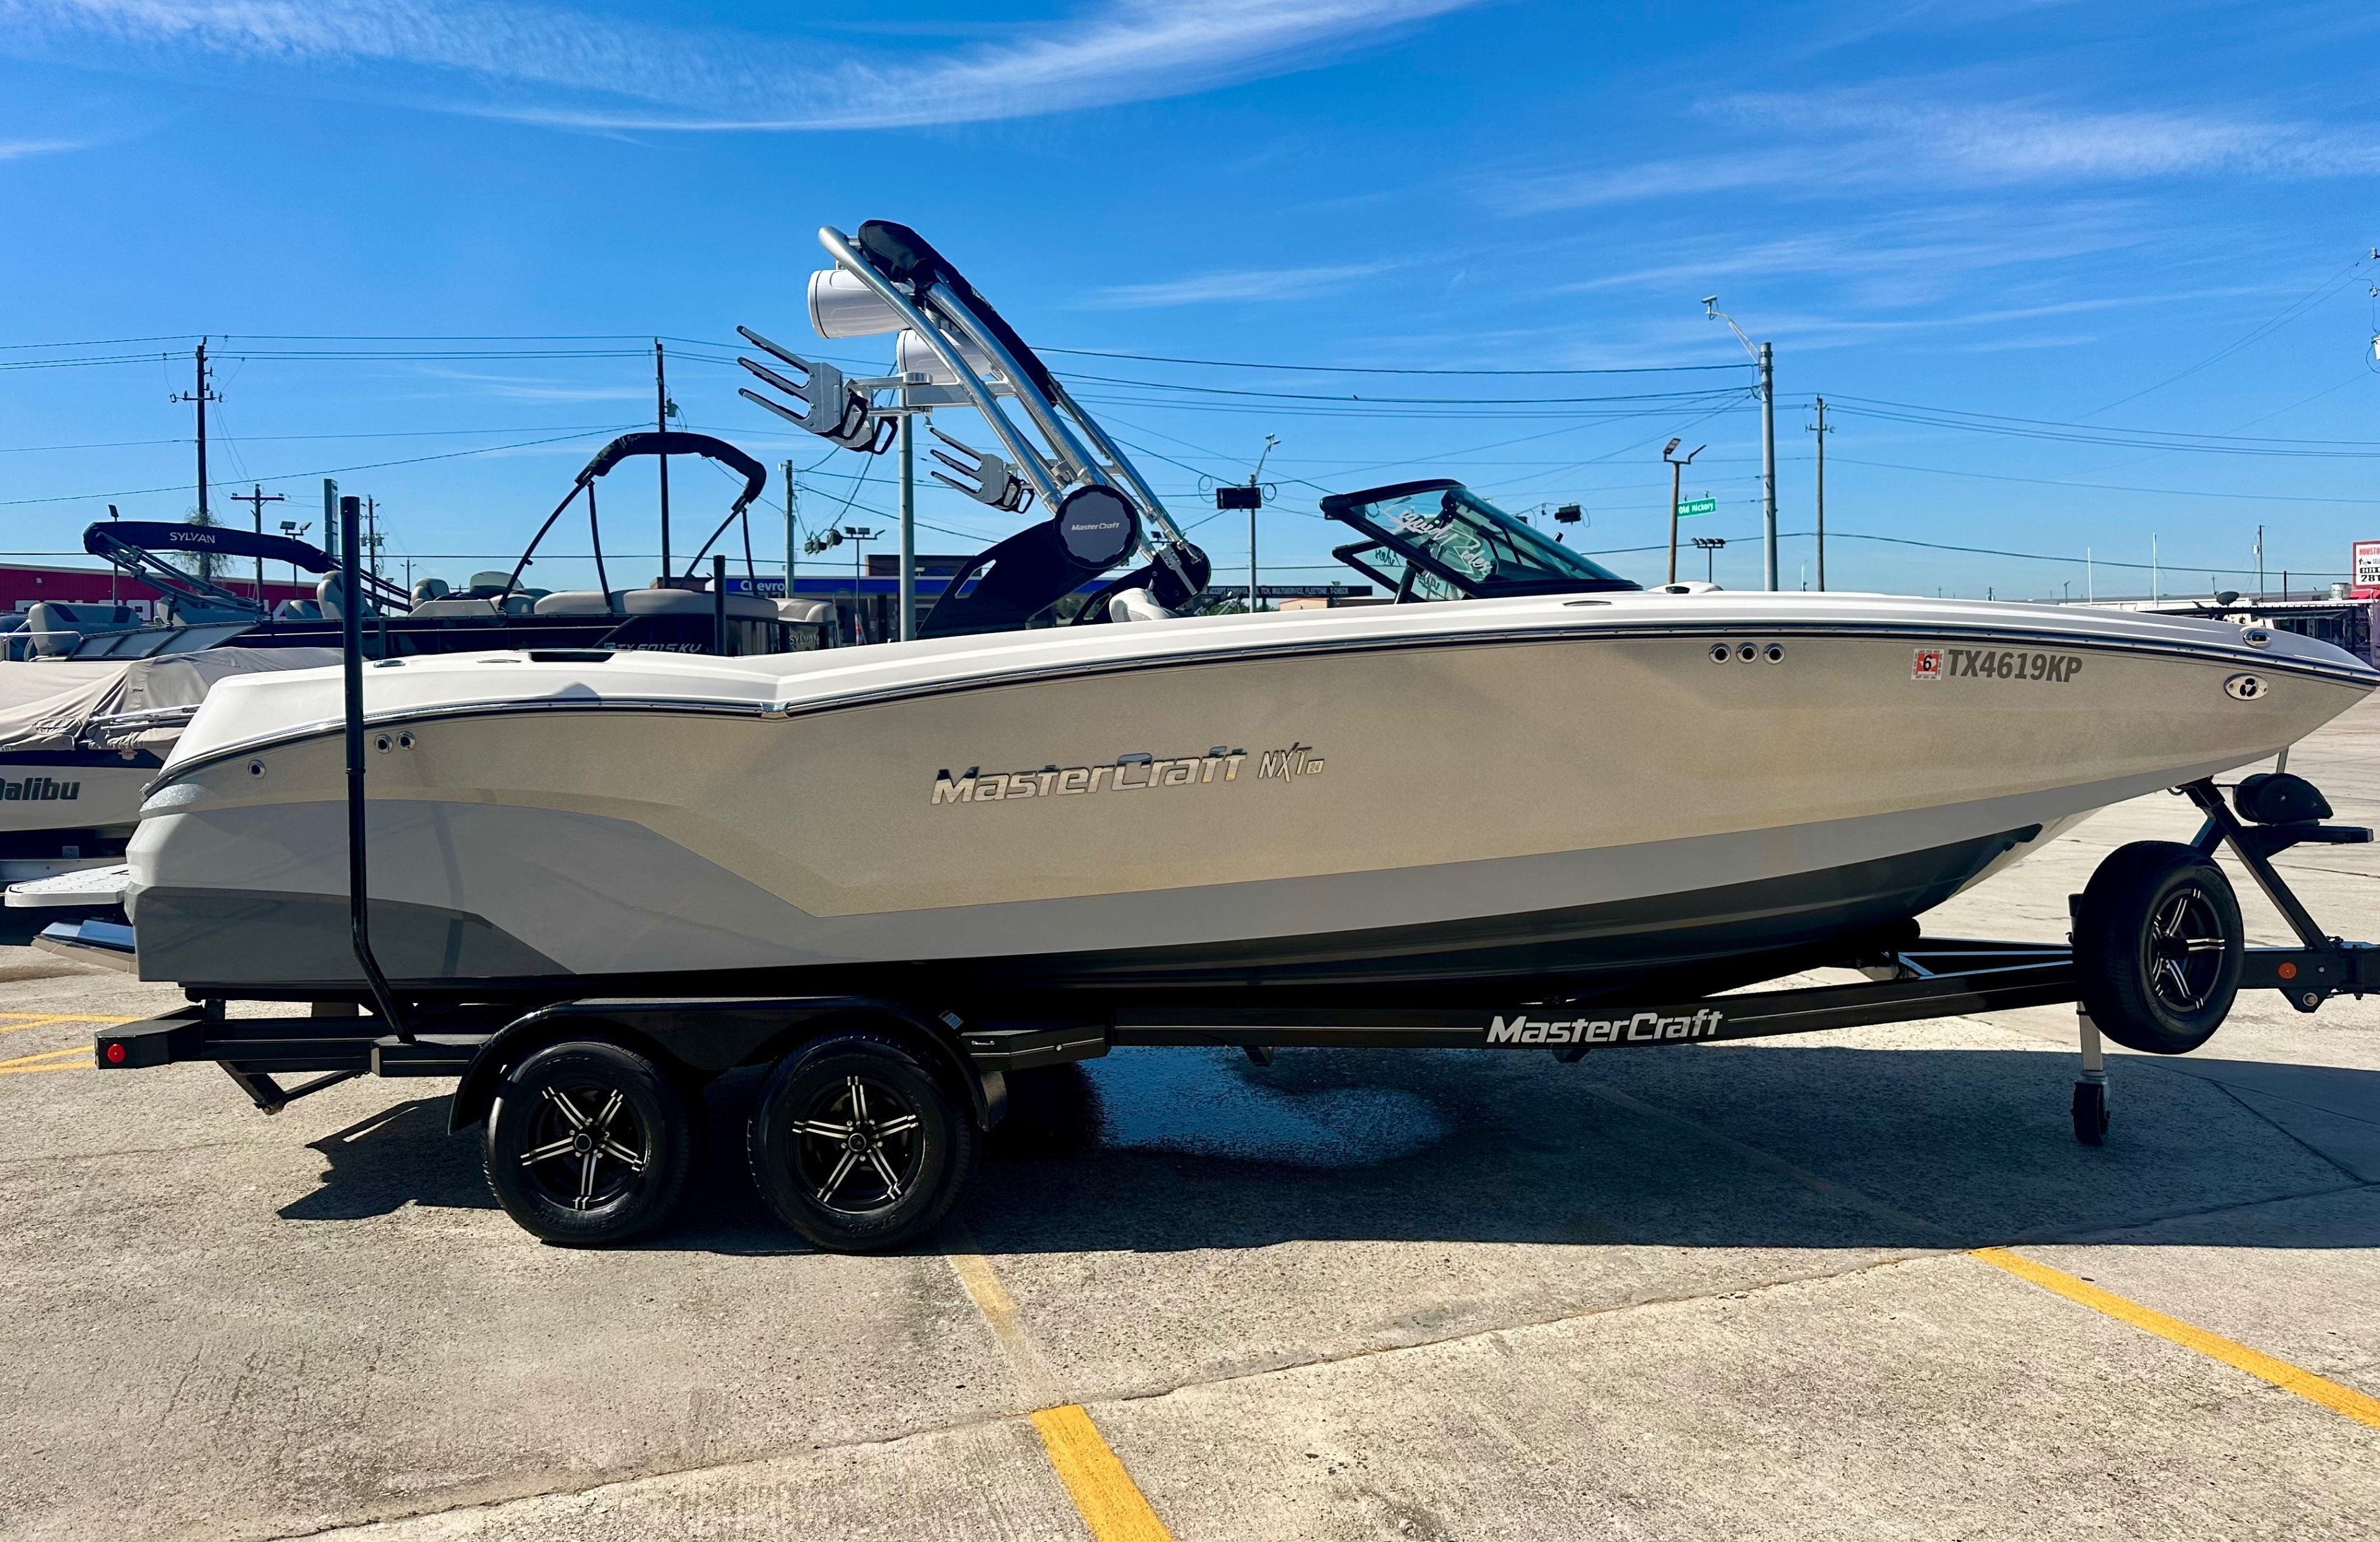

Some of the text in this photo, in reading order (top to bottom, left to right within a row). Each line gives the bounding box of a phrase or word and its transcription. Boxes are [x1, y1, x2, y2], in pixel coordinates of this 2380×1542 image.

[1678, 503, 1714, 514] Old Hickory
[170, 532, 215, 543] SYLVAN
[1071, 522, 1119, 531] MasterCraft
[1378, 496, 1492, 574] Liquid Rides
[789, 635, 819, 645] SYLVAN
[1923, 649, 2082, 682] 6 TX4619KP
[931, 746, 1247, 804] MasterCraft
[1258, 742, 1312, 782] NXT
[1486, 1009, 1723, 1042] MasterCraft
